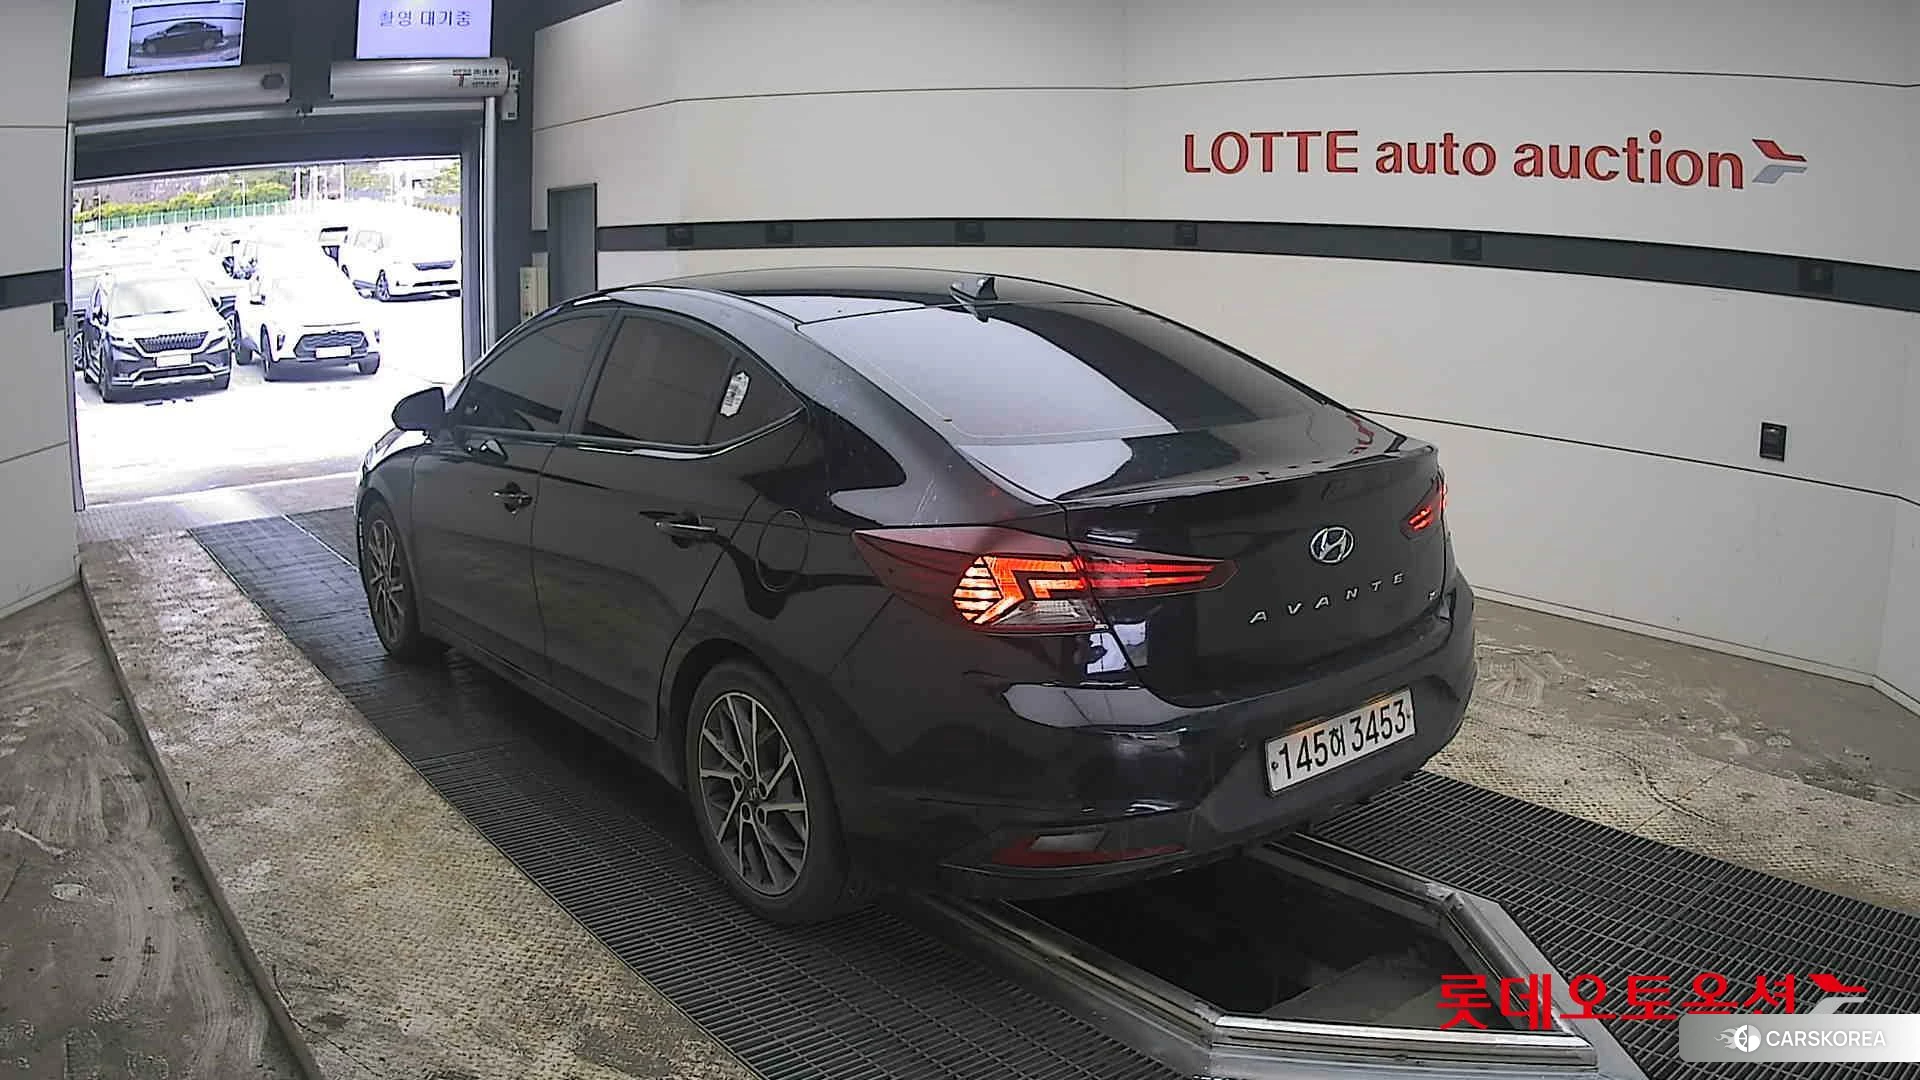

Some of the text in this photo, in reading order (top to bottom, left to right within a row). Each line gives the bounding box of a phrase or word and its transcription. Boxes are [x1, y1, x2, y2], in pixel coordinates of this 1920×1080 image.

[1184, 129, 1744, 189] LOTTE auto auction
[1249, 572, 1405, 624] AVANTE
[1278, 699, 1406, 780] 145허 3453
